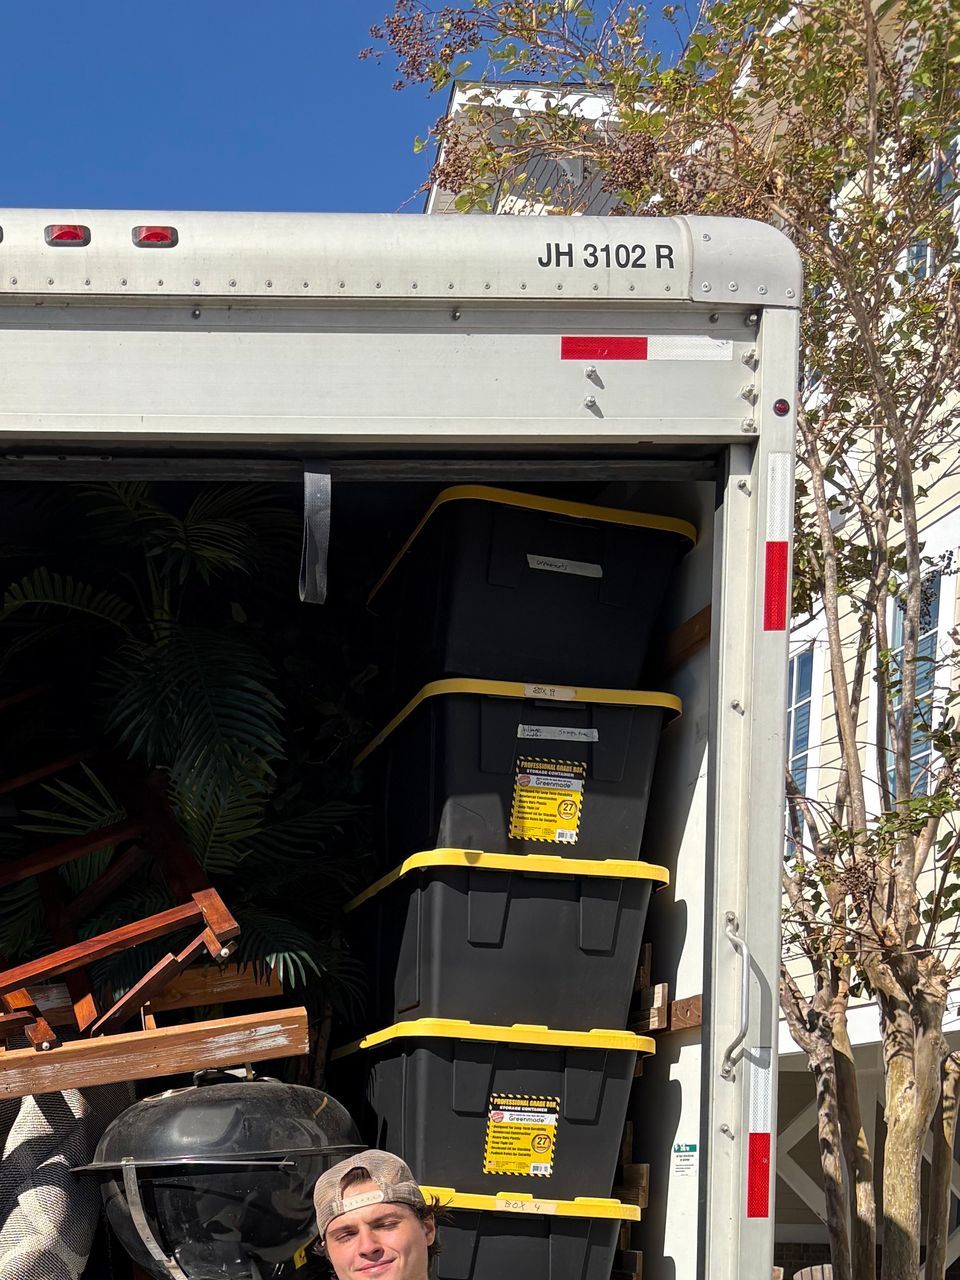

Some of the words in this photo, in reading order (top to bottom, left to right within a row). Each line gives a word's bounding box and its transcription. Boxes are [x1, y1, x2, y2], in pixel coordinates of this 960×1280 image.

[537, 243, 574, 268] JH
[583, 243, 647, 268] 3102
[655, 244, 675, 269] R
[521, 761, 556, 770] PROFESSIONAL
[556, 764, 573, 772] GRADE
[572, 766, 583, 774] BOX
[563, 802, 574, 812] 27
[493, 1097, 529, 1107] PROFESSIONAL
[529, 1100, 546, 1108] GRADE
[537, 1136, 548, 1145] 27
[504, 1199, 526, 1211] BOX
[534, 1203, 541, 1212] 4
